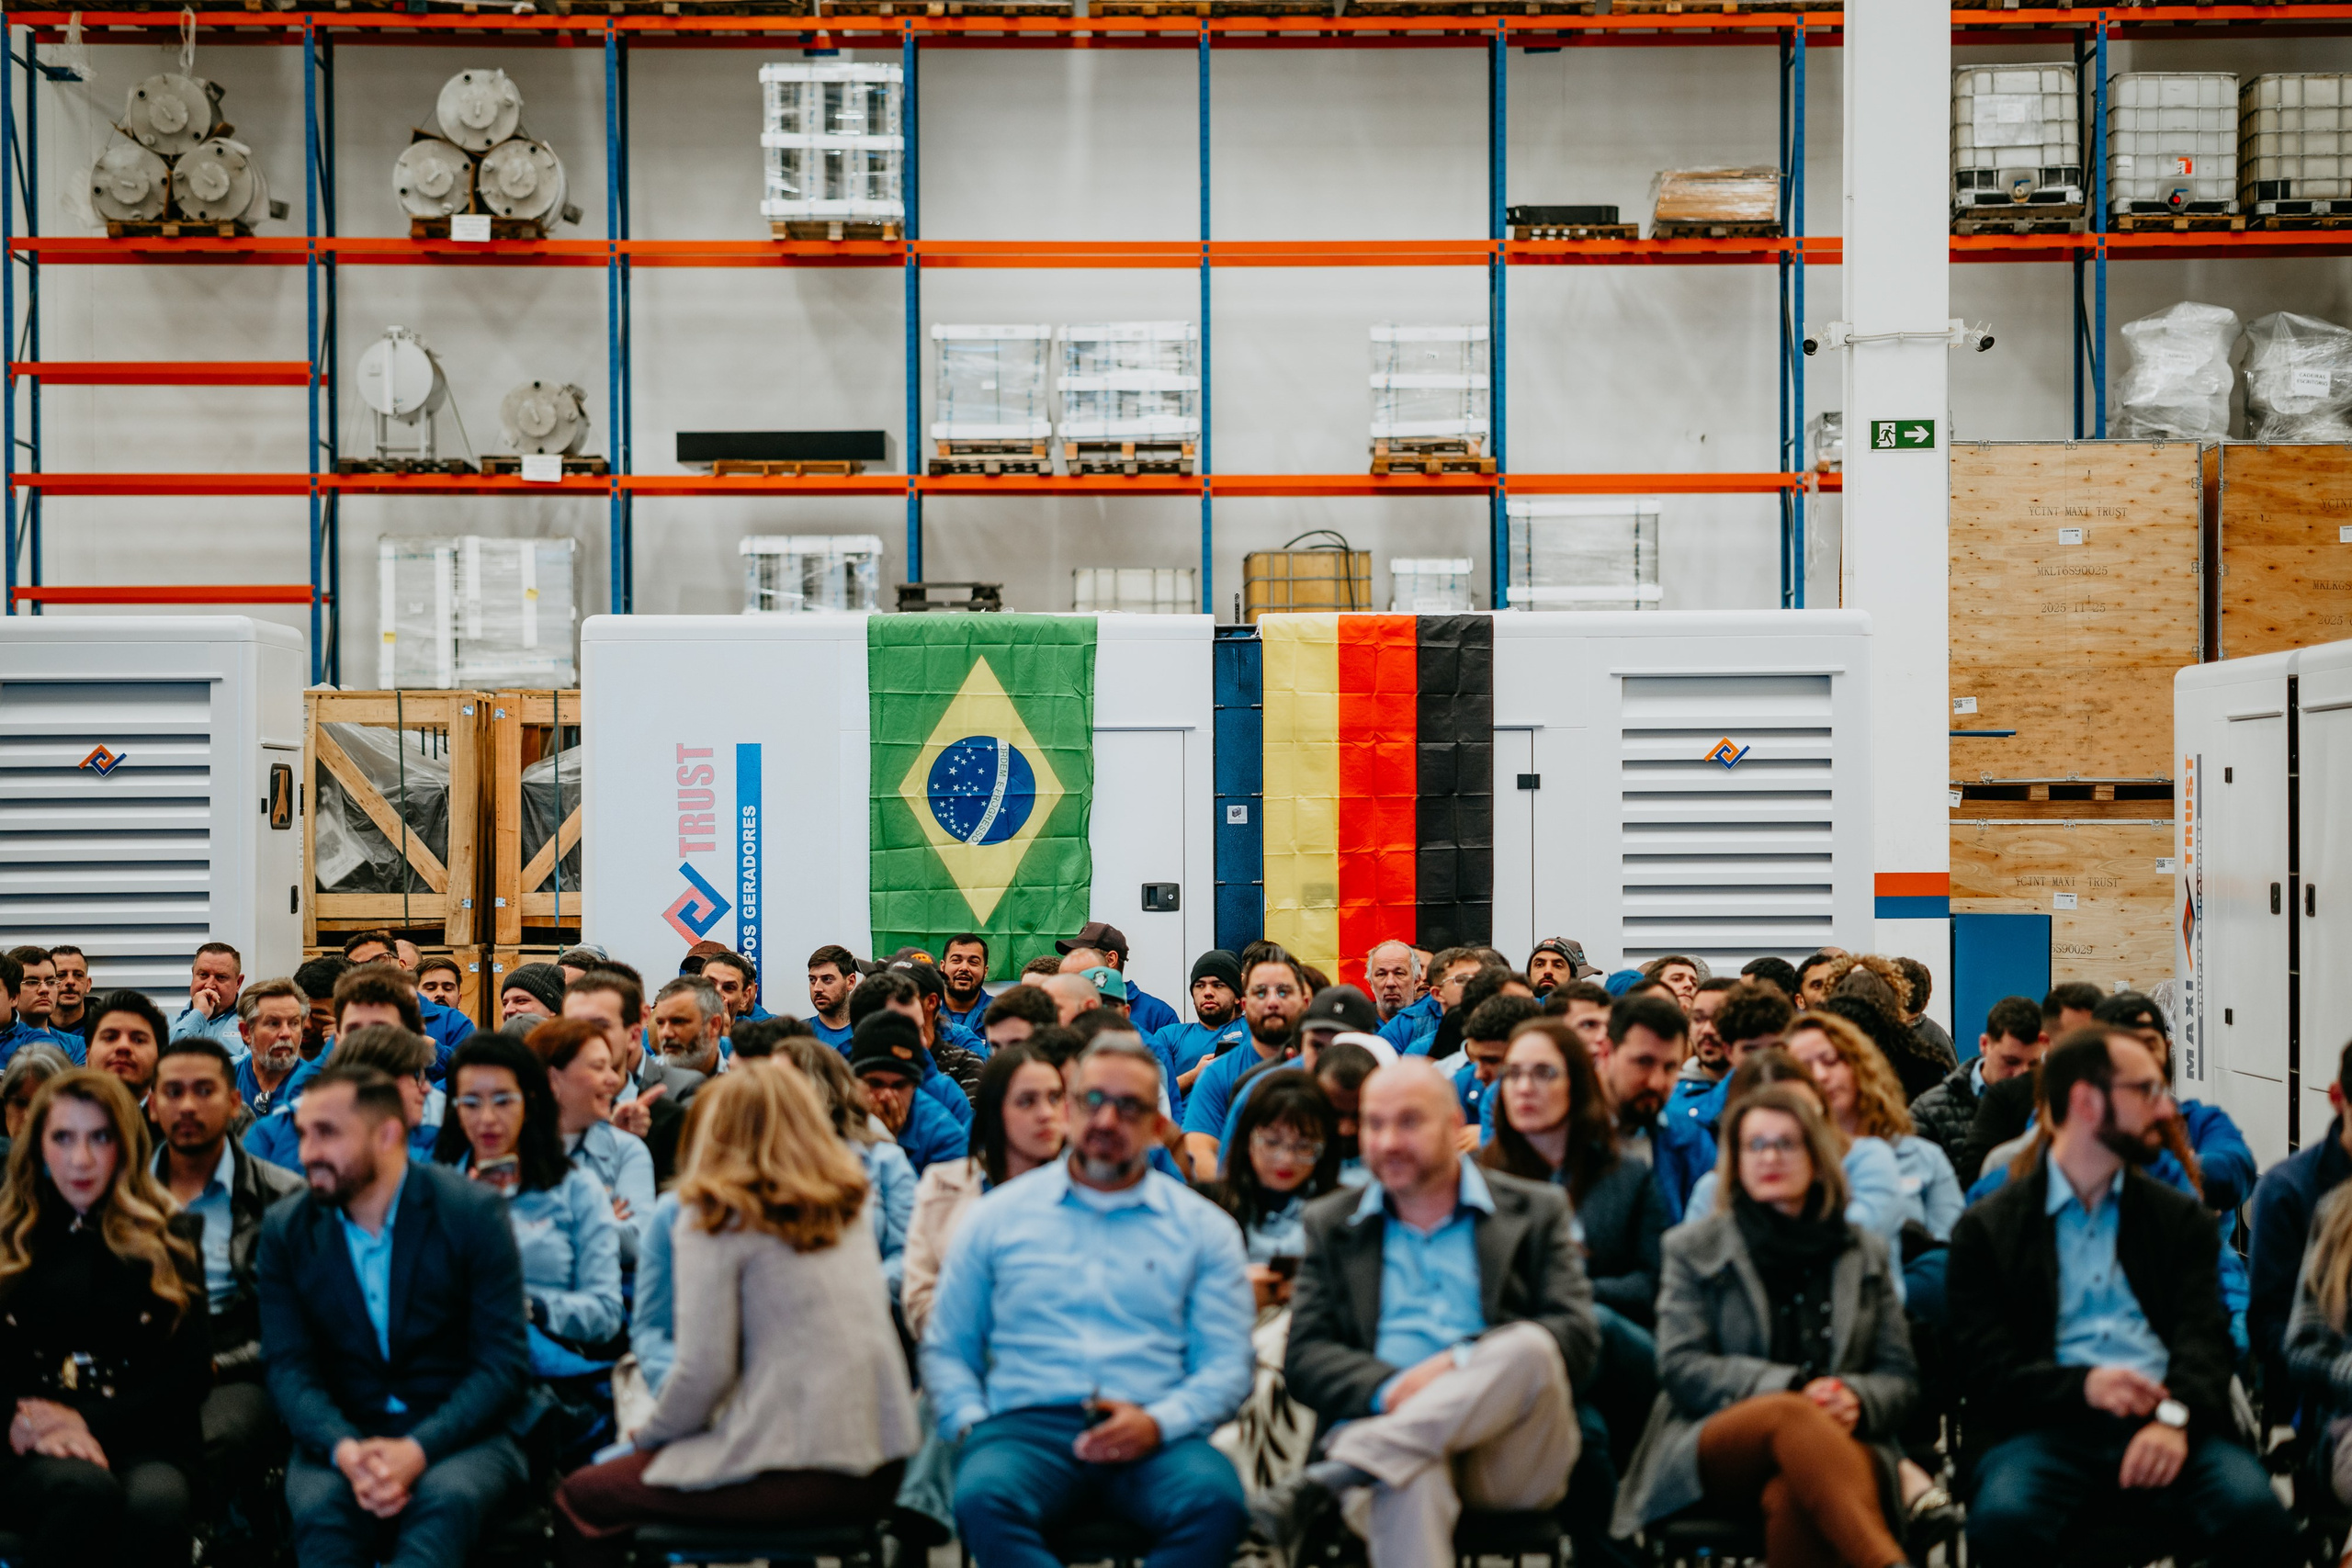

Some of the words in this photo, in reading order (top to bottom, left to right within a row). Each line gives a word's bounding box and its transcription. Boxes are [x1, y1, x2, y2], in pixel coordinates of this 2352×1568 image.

[2029, 506, 2060, 517] YCINT
[2064, 506, 2089, 517] MAXI
[2096, 506, 2128, 517] TRUST
[2321, 498, 2352, 509] YCINT
[2041, 603, 2066, 614] 2025
[2092, 603, 2107, 613] 25
[2317, 615, 2343, 626] 2025
[1000, 744, 1008, 777] ORDEM
[676, 742, 716, 858] TRUST
[971, 788, 1002, 843] PROGRESSO
[2185, 753, 2194, 870] TRUST
[742, 805, 756, 919] GERADORES
[2015, 876, 2046, 886] YCINT
[2052, 876, 2076, 886] MAXI
[2087, 876, 2119, 887] TRUST
[742, 924, 756, 970] POS
[2185, 980, 2195, 1080] MAXI
